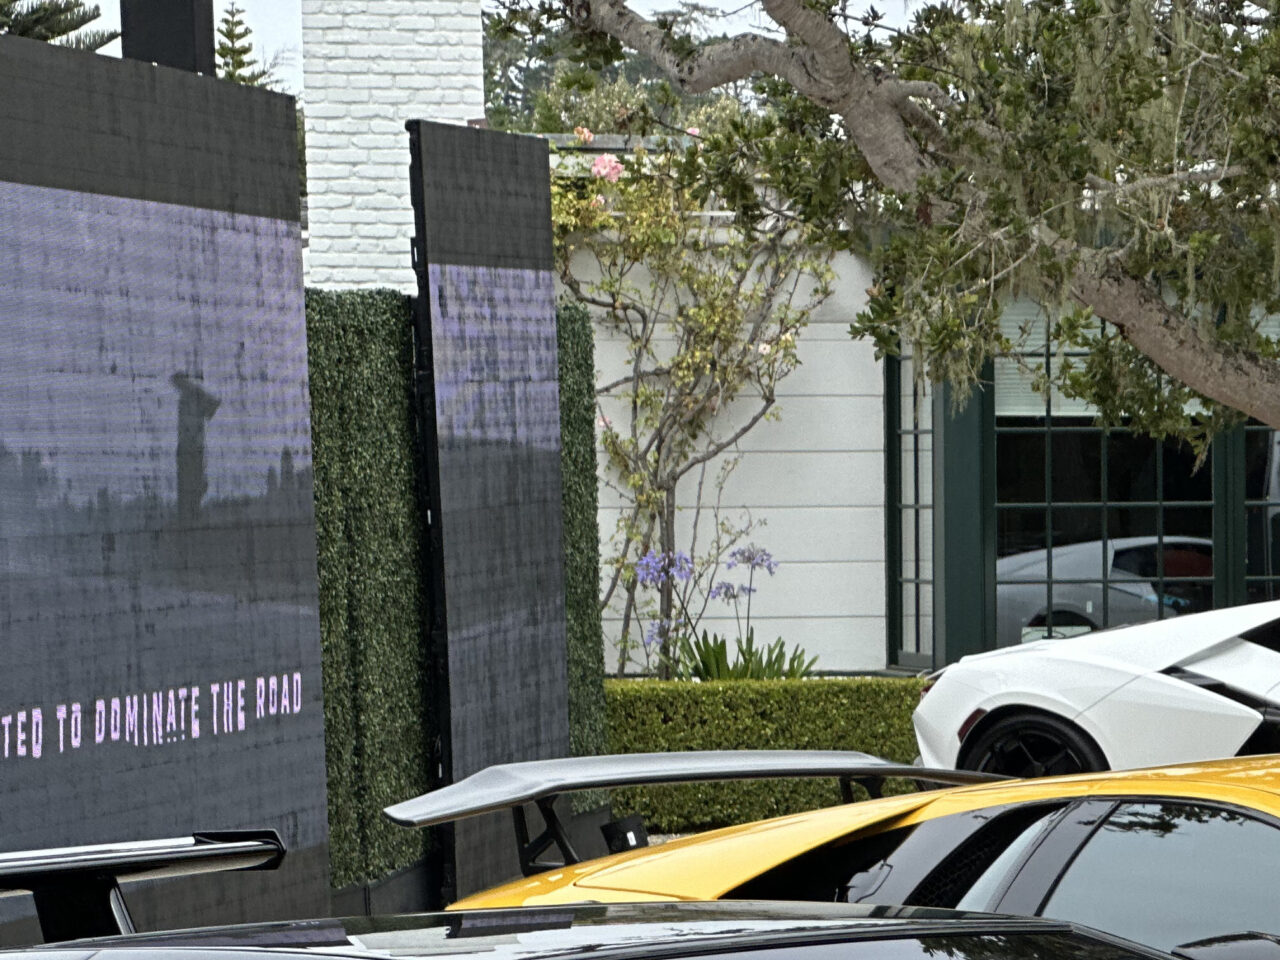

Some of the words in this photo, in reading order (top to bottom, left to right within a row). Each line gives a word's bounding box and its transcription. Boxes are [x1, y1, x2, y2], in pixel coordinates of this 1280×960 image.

[1, 707, 43, 759] TED
[56, 702, 82, 753] TO
[95, 685, 200, 746] DOMINATE
[210, 679, 246, 735] THE
[256, 672, 302, 719] ROAD
